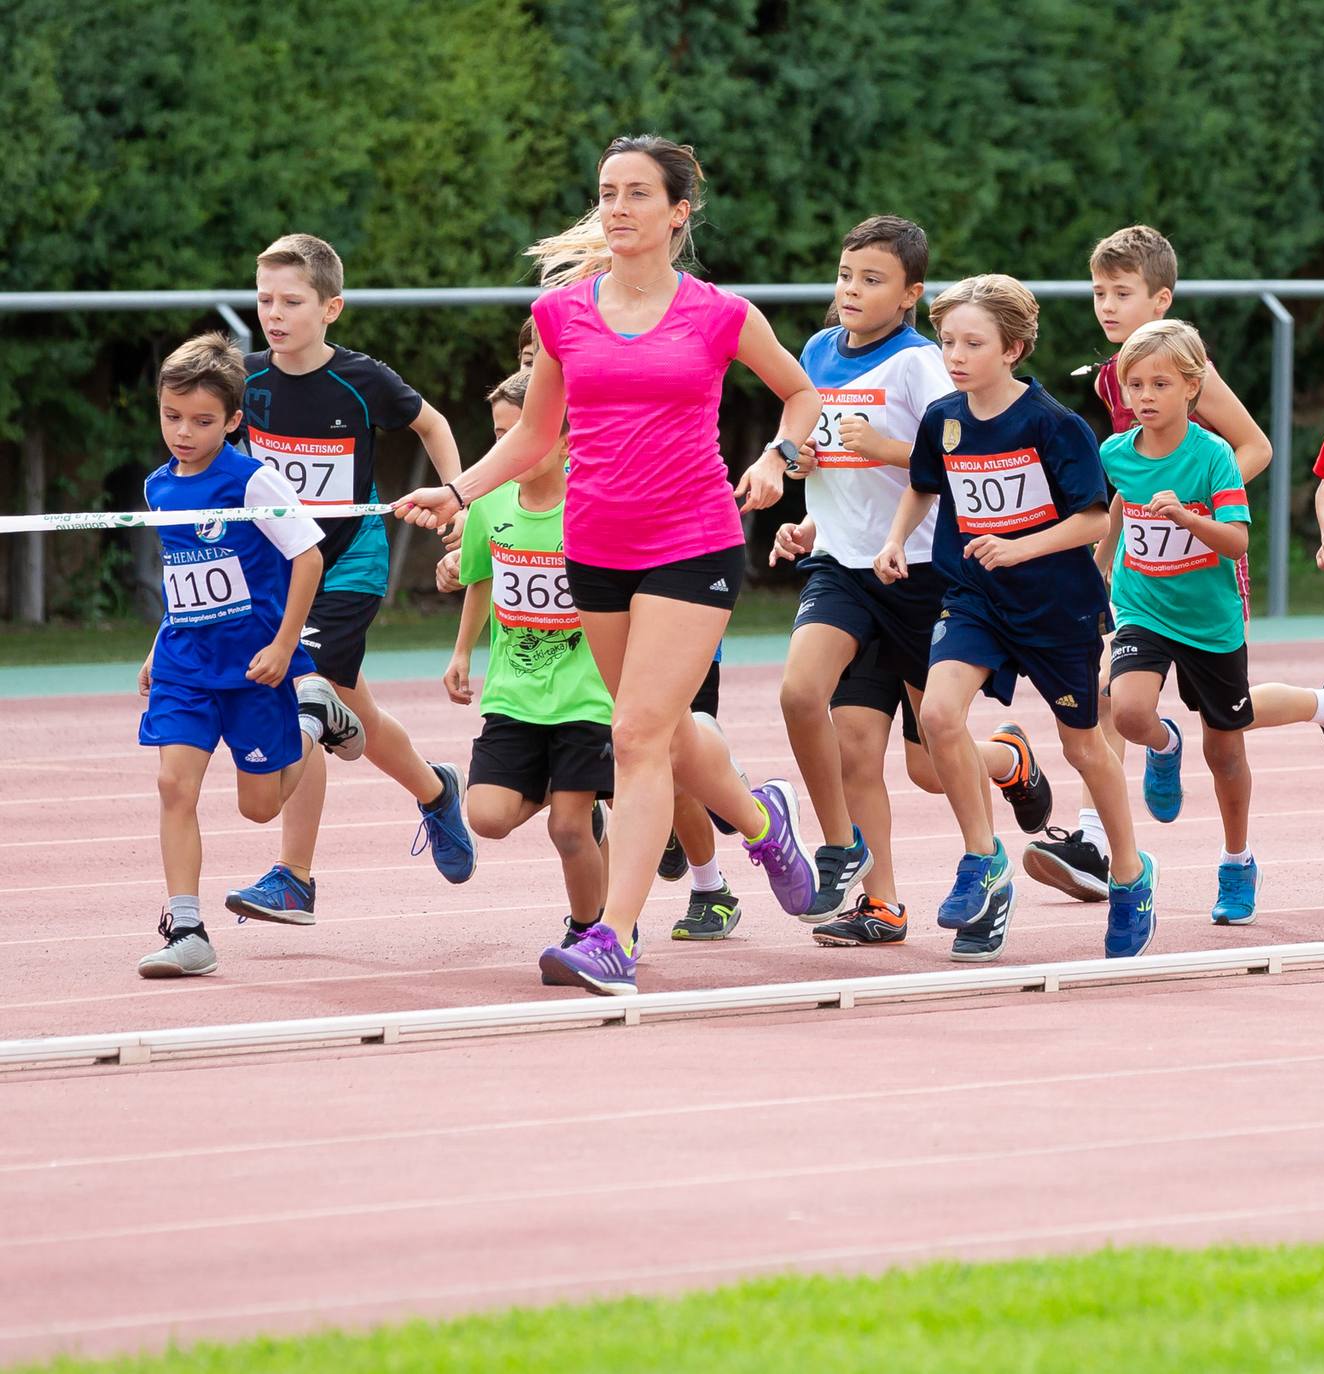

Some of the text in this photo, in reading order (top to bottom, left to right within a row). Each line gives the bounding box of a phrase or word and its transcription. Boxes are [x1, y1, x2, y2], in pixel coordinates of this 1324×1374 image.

[820, 394, 875, 403] OJA ATLETISMO
[255, 434, 345, 454] LA RIOJA ATLETISMO
[950, 454, 1031, 471] LA RIOJA ATLETISMO
[265, 456, 335, 498] 97
[963, 473, 1026, 513] 307
[1130, 524, 1194, 558] 377
[172, 547, 229, 564] HEMAFIX
[502, 553, 528, 564] RIOJA
[170, 567, 232, 608] 110
[503, 571, 575, 609] 368
